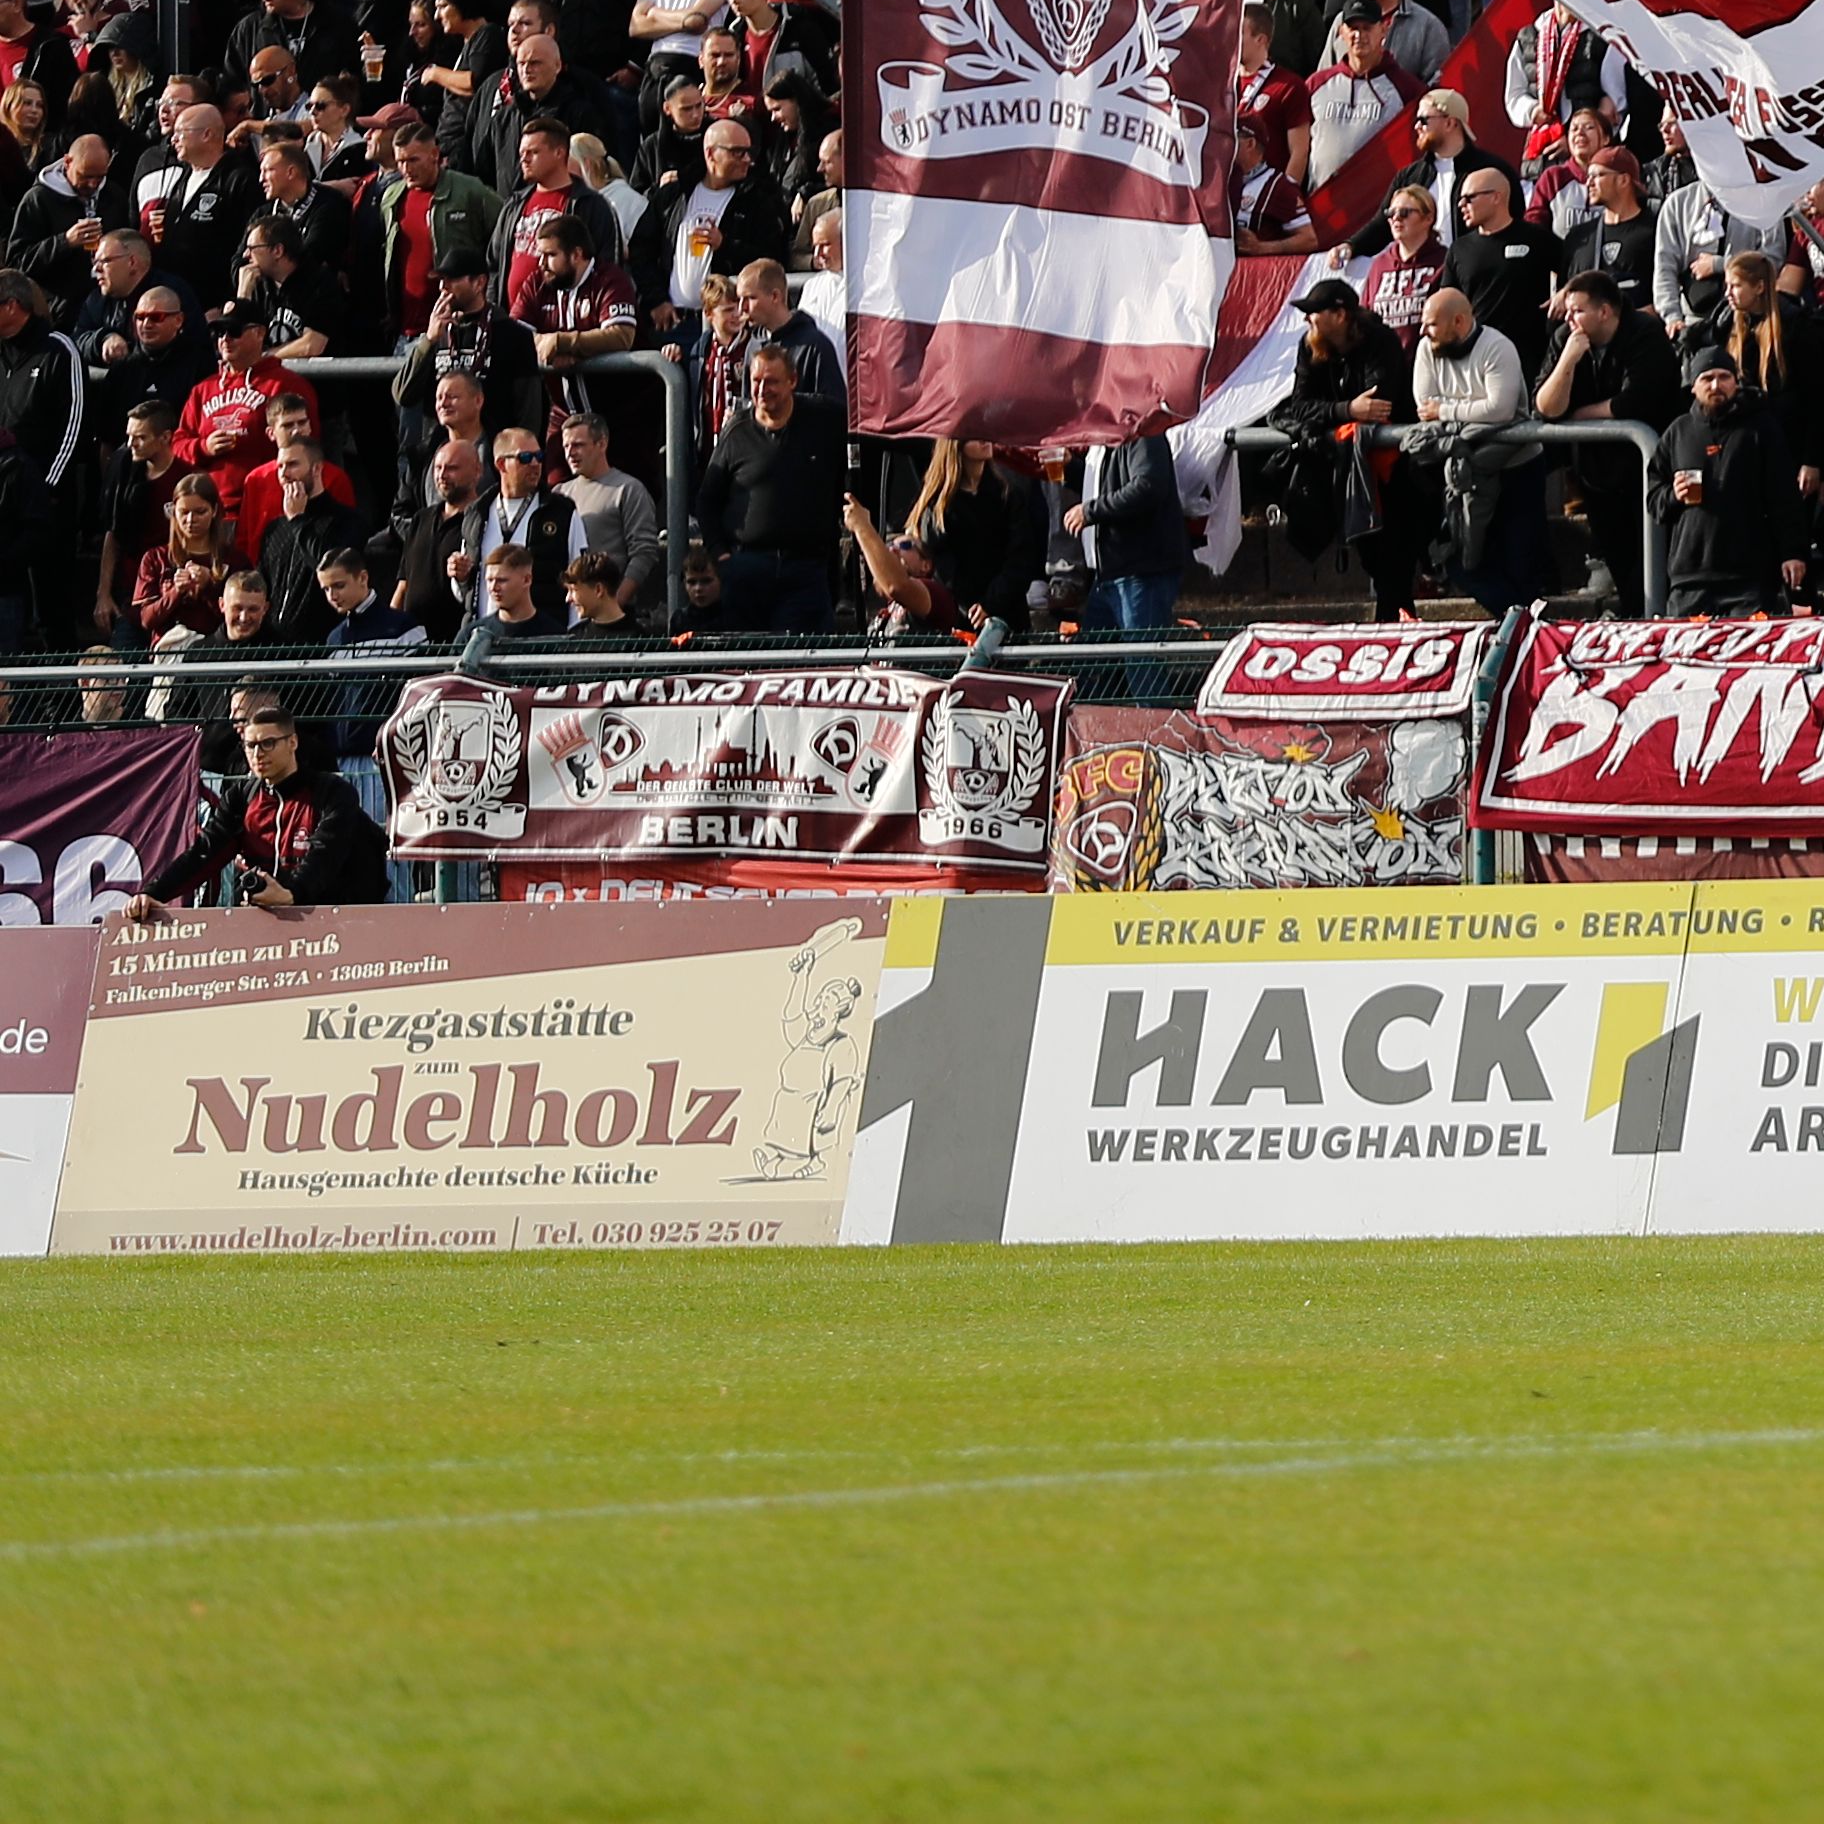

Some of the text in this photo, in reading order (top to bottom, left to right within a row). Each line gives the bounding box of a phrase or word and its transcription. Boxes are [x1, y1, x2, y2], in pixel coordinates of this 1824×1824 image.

[1325, 101, 1382, 122] DYNAMO
[917, 99, 1186, 165] DYNAMO OST BERLIN
[1378, 266, 1436, 299] BFC
[202, 386, 267, 420] HOLLISTER
[533, 678, 750, 703] DYNAMO
[636, 779, 662, 793] DER
[715, 778, 752, 793] CLUB
[755, 779, 781, 793] DER
[783, 780, 816, 795] WELT
[423, 807, 489, 831] 1954
[638, 814, 800, 848] BERLIN
[942, 816, 1003, 840] 1966
[112, 919, 208, 946] Ab hier
[1112, 917, 1267, 947] VERKAUF
[1278, 918, 1301, 942] &
[1317, 912, 1539, 942] VERMIETUNG
[1580, 907, 1764, 938] BERATUNG
[108, 933, 341, 977] 15 Minuten zu Fuß
[105, 954, 450, 1006] Falkenberger Str. 37A 13088 Berlin
[302, 1001, 635, 1054] Kiezgaststätte
[1090, 983, 1570, 1107] HACK
[413, 1059, 461, 1075] zum
[173, 1060, 743, 1156] Nudelholz
[1086, 1123, 1550, 1163] WERKZEUGHANDEL
[237, 1159, 660, 1196] Hausgemachte deutsche Küche
[108, 1218, 784, 1253] www.nudelholz-berlin.com Tel. 030 925 25 07
